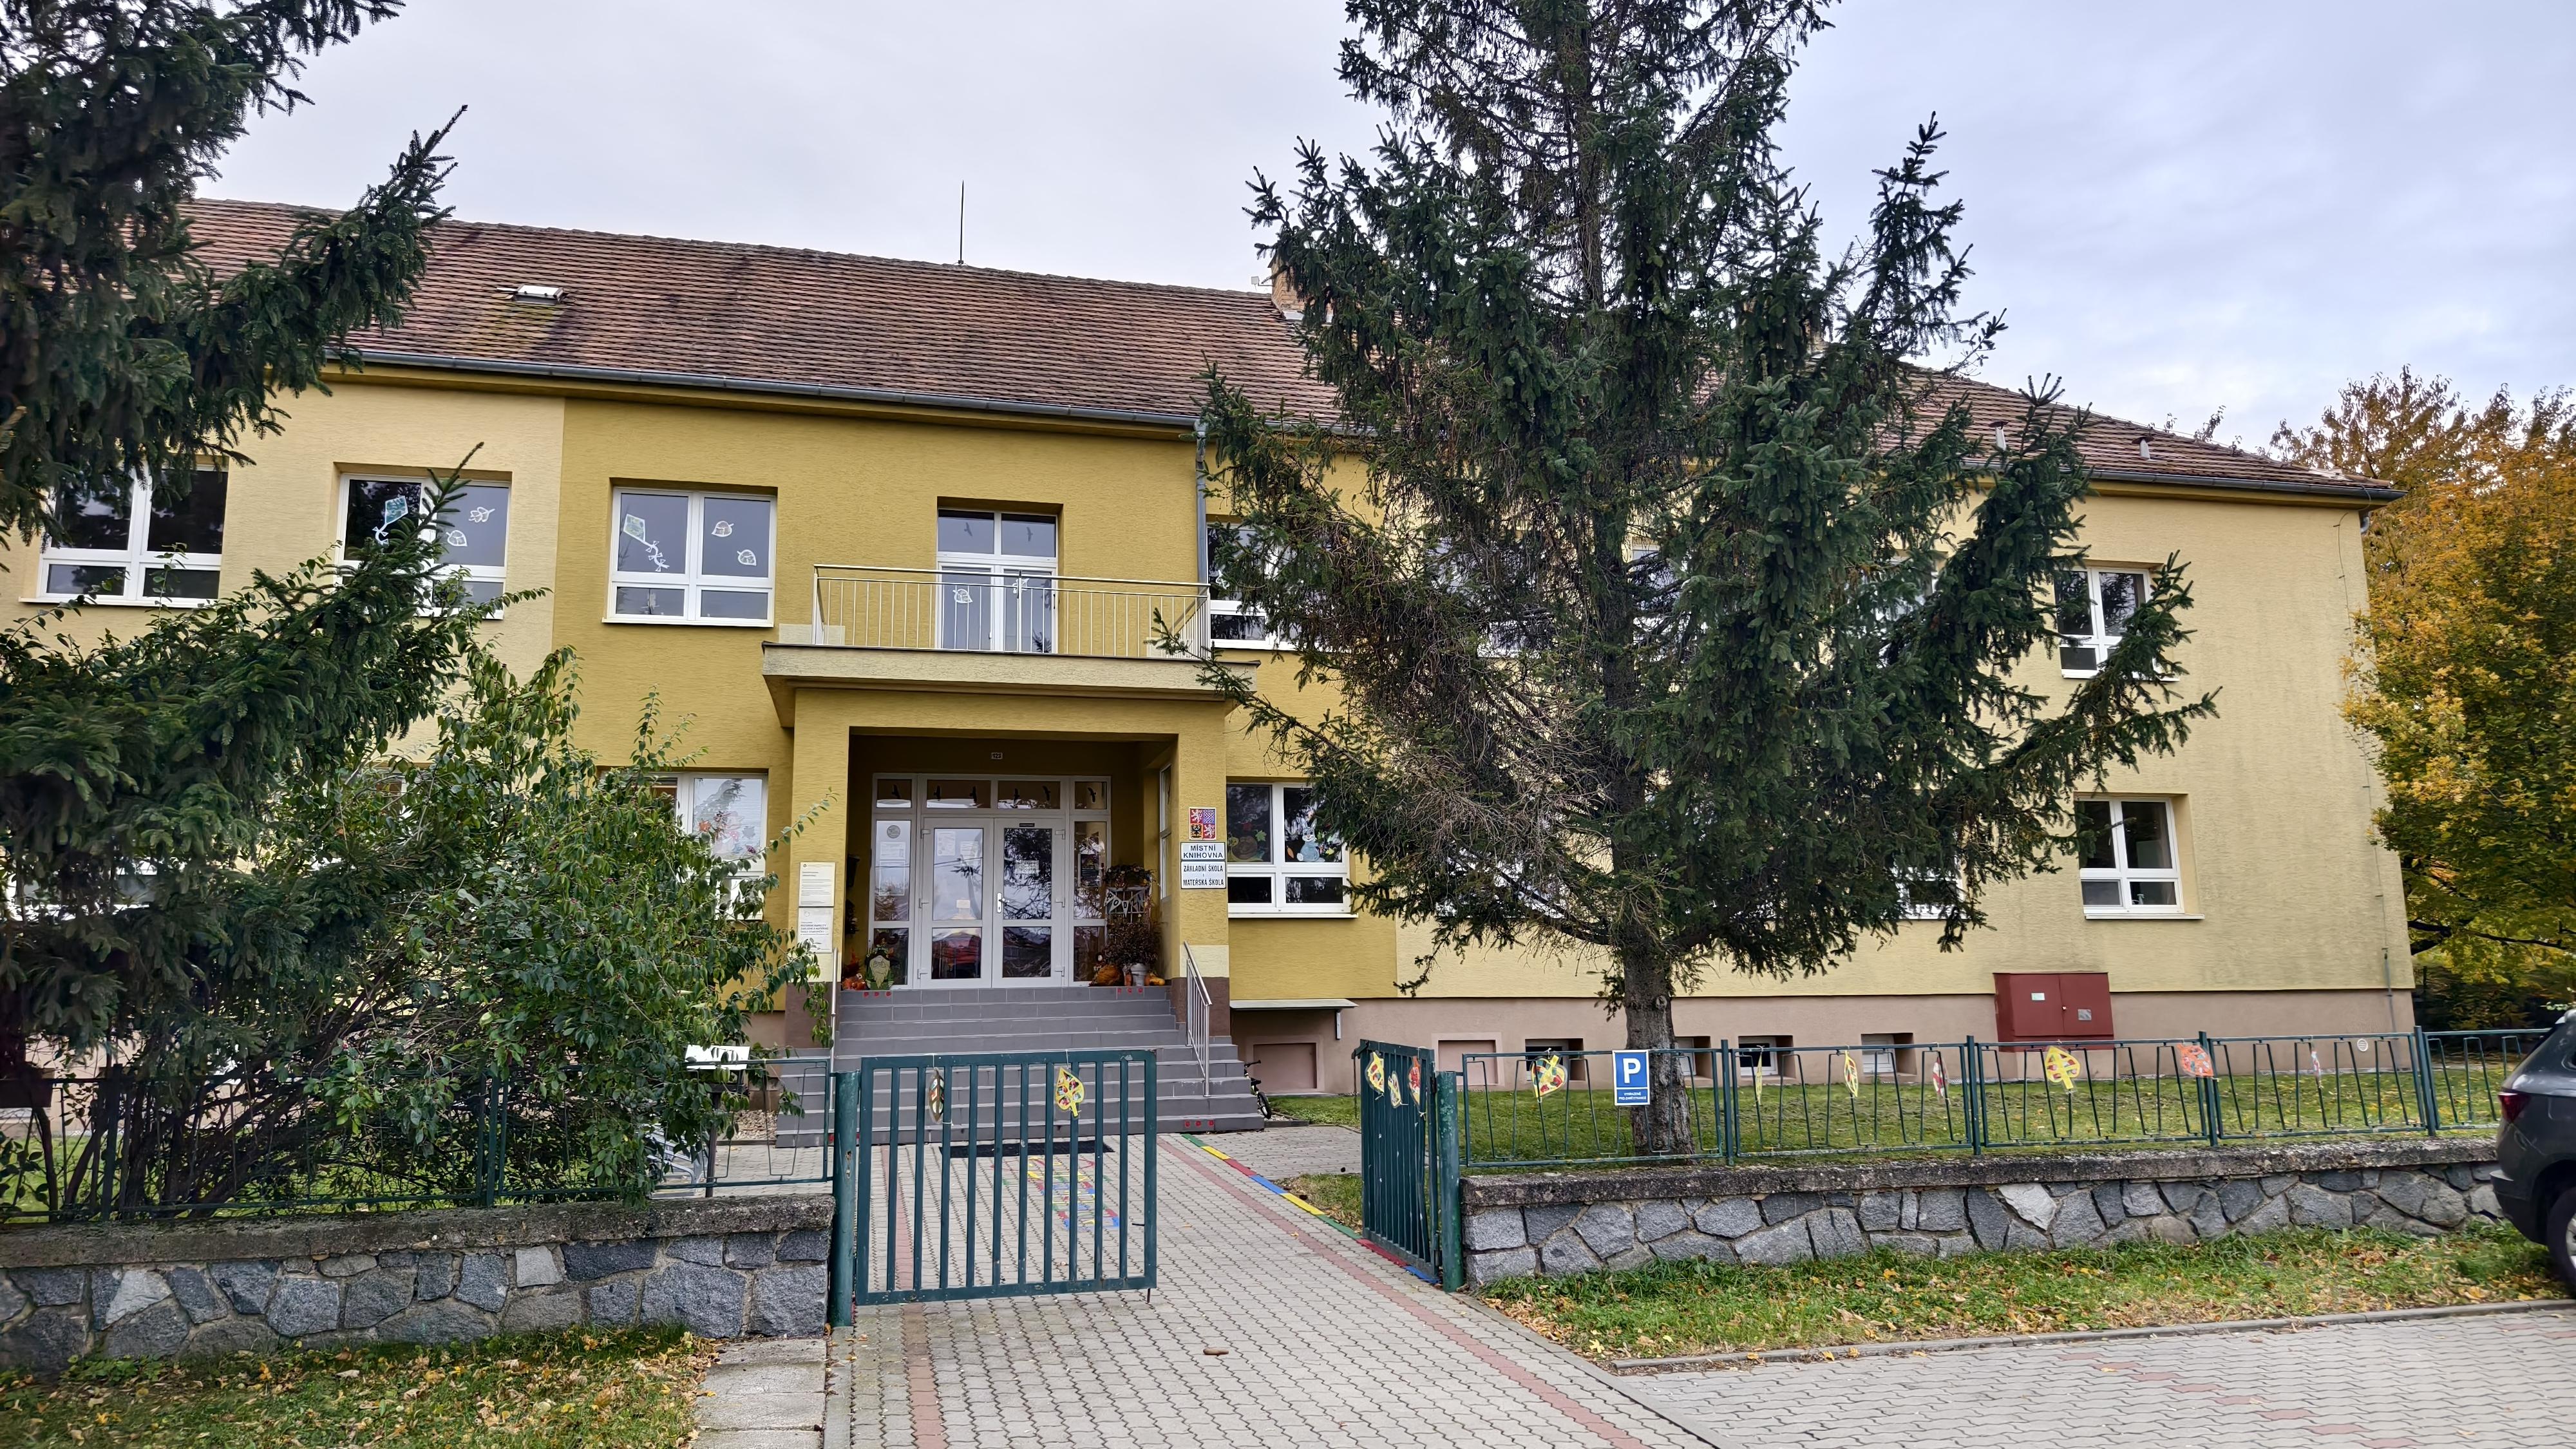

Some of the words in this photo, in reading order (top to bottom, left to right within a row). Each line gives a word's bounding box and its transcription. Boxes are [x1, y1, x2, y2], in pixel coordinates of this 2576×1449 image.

[1183, 864, 1207, 872] ZÁKLADNÍ
[1208, 864, 1223, 872] ŠKOLA
[1183, 878, 1208, 886] MATEŘSKÁ
[1623, 1058, 1641, 1084] P
